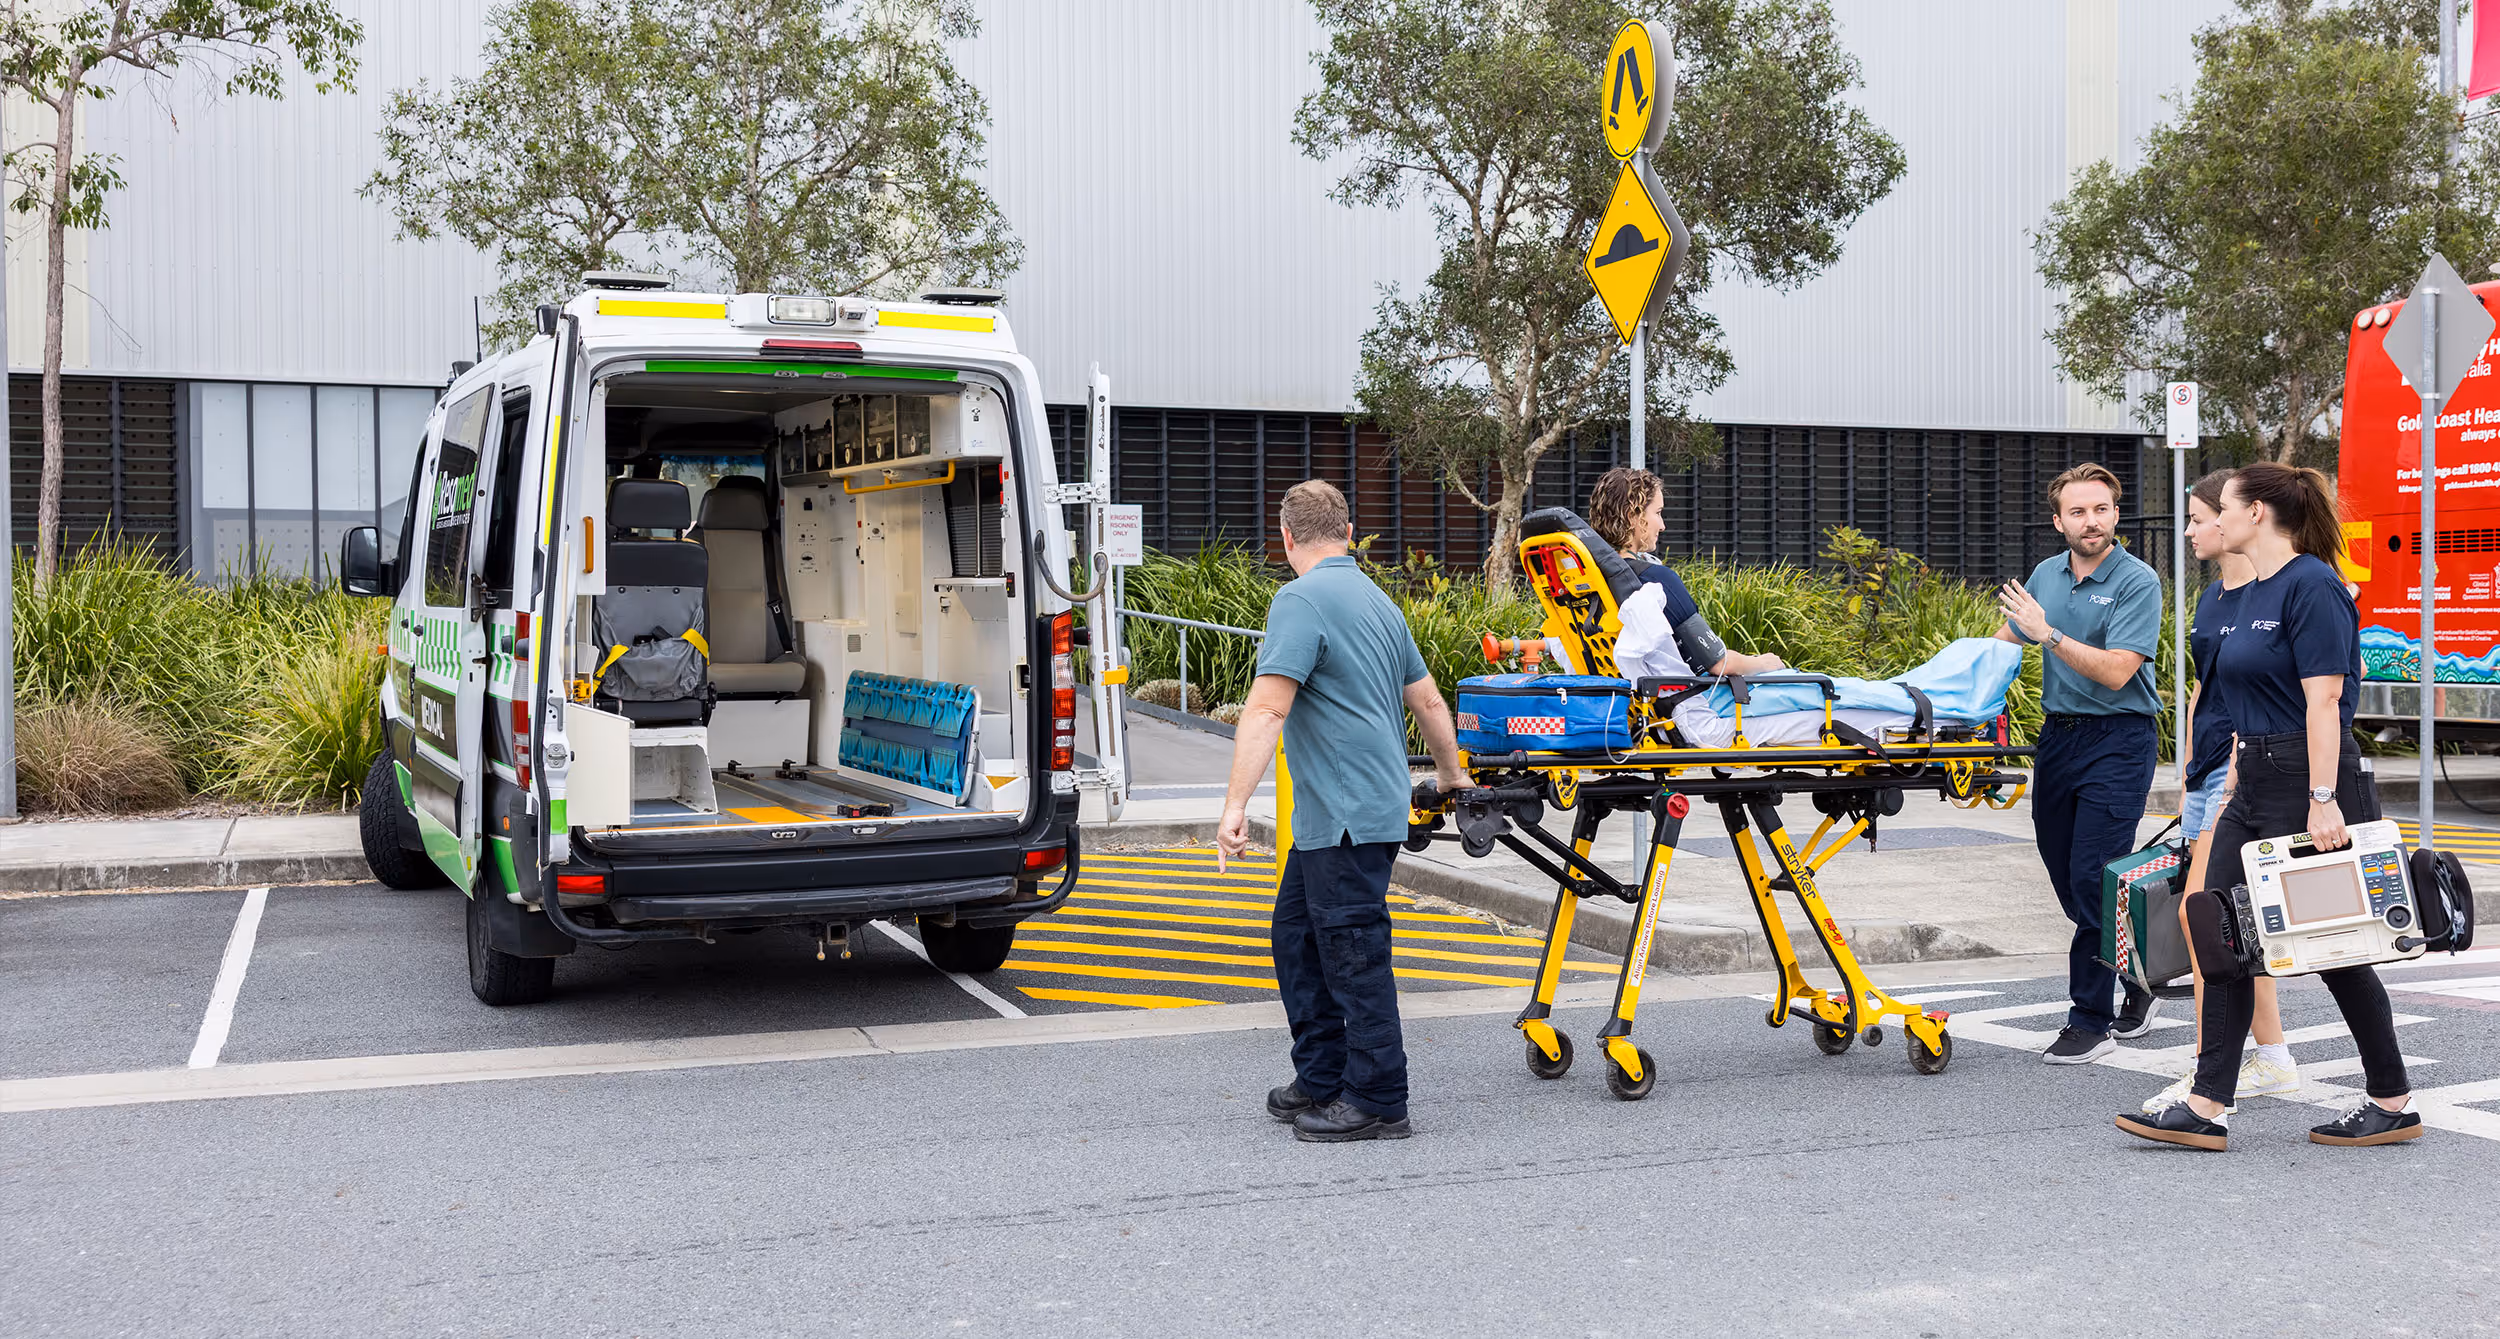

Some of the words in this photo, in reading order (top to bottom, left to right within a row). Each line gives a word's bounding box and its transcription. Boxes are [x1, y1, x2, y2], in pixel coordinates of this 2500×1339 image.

[2397, 413, 2422, 432] Gol
[2460, 428, 2496, 443] always
[1781, 844, 1817, 899] stryker
[1633, 957, 1644, 980] Align
[1639, 934, 1649, 958] Arrows
[1645, 902, 1656, 930] Before
[1652, 869, 1665, 902] Loading
